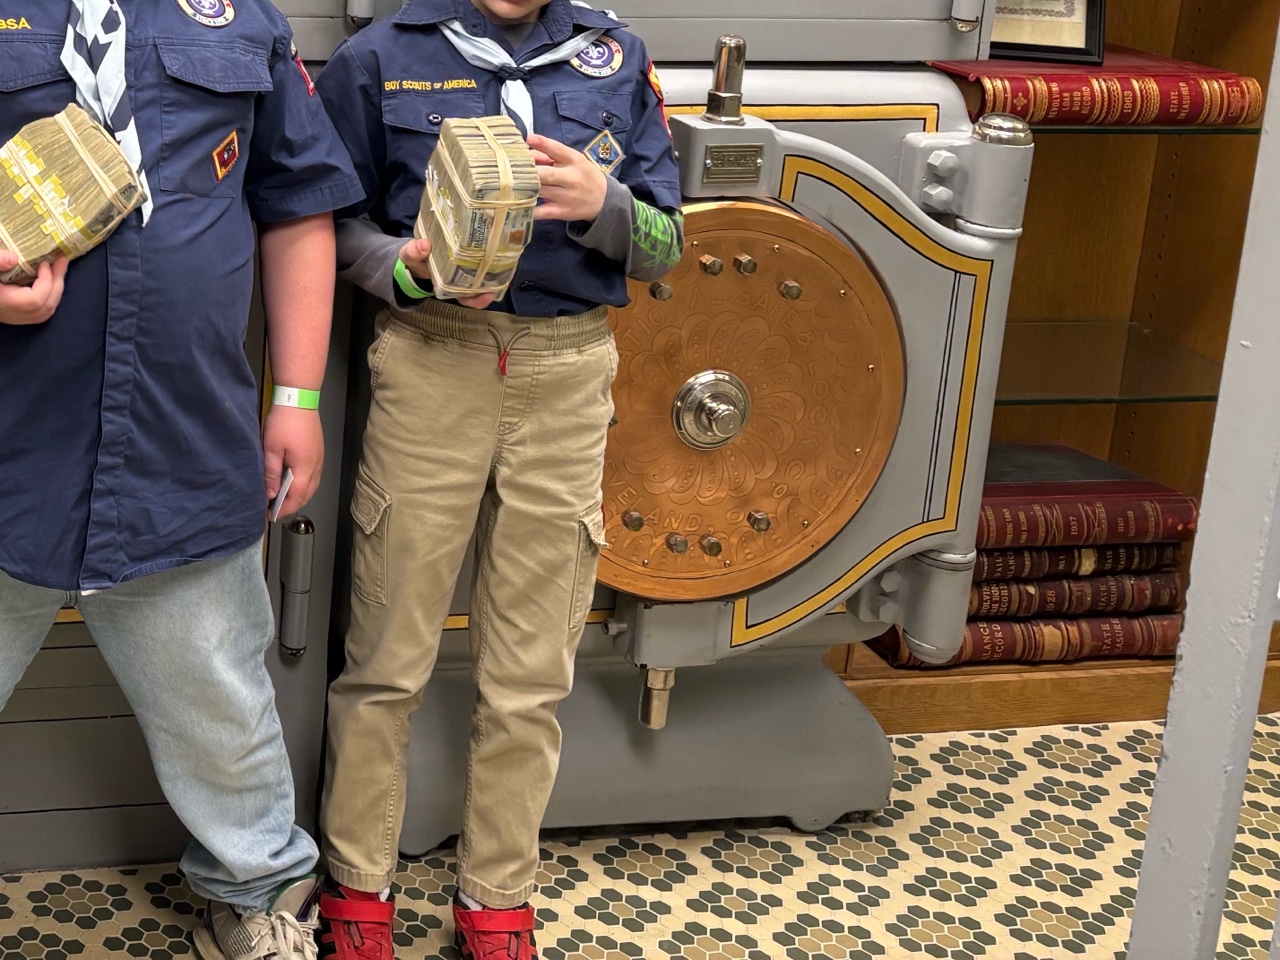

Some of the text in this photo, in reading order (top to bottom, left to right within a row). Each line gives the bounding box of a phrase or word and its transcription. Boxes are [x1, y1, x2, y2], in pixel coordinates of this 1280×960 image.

[384, 80, 400, 91] BOY
[402, 80, 432, 91] SCOUTS
[443, 78, 477, 90] AMERICA
[1047, 82, 1060, 118] REVOLVING
[1062, 92, 1071, 111] LOAN
[1073, 91, 1081, 111] BOND
[1081, 86, 1091, 114] RECORD
[1169, 90, 1179, 113] STATE
[1177, 82, 1191, 120] TREASURER
[737, 291, 801, 328] SAFE
[804, 358, 830, 447] LOCK
[1002, 508, 1012, 521] LOAN
[1069, 516, 1078, 535] 1937
[1006, 551, 1016, 578] ALANCE
[990, 581, 1000, 601] BON
[977, 621, 992, 660] ALANCE
[991, 623, 1004, 660] ECORD
